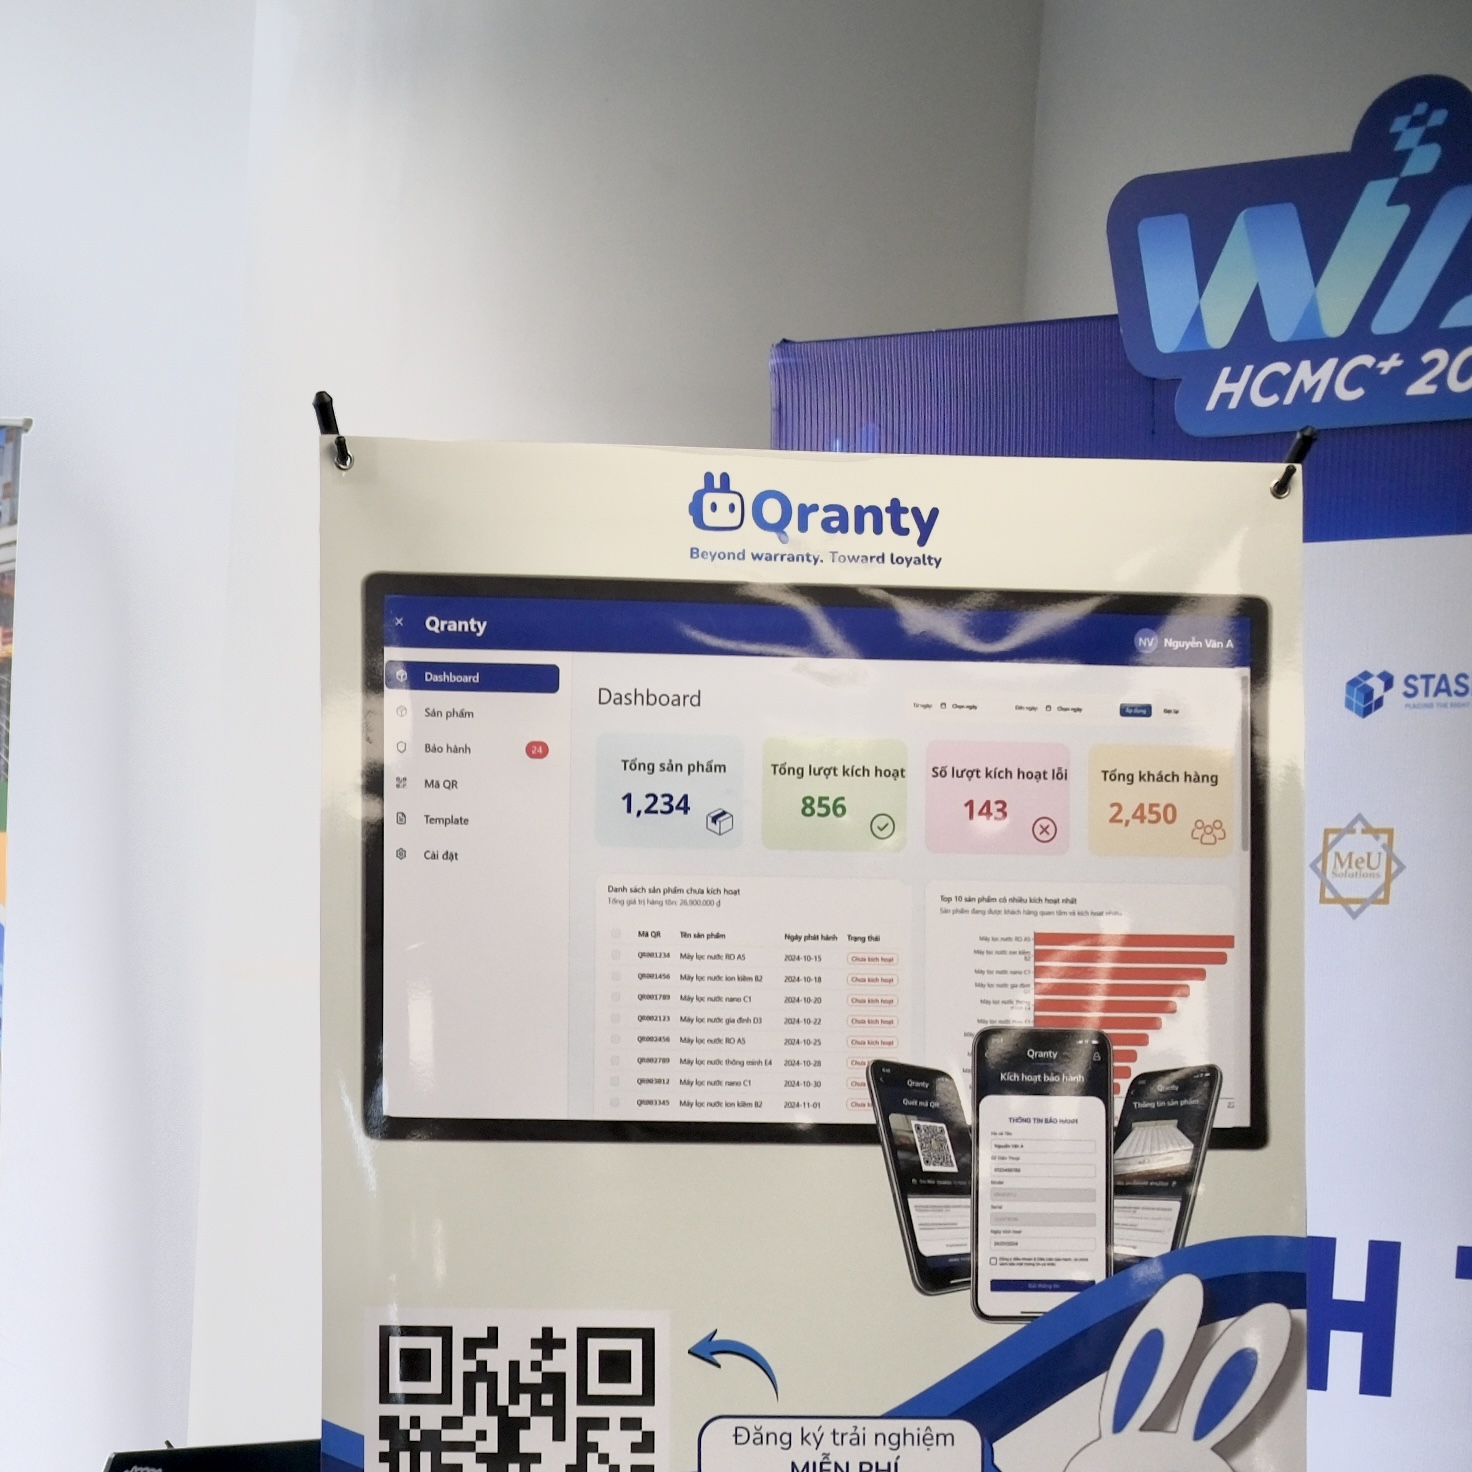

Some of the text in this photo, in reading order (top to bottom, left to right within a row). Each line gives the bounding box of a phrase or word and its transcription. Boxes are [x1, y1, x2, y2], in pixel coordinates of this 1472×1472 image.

[751, 488, 940, 547] Qranty
[689, 546, 942, 569] Beyond warranty. Toward loyalty
[425, 615, 487, 636] Qranty
[1139, 637, 1155, 647] NV
[1164, 636, 1233, 650] Nguyễn Văn A
[424, 671, 479, 683] Dashboard
[1402, 673, 1472, 699] STAS
[598, 687, 700, 707] Dashboard
[424, 707, 474, 720] Sản phẩm
[424, 743, 471, 754] Bảo hành
[531, 745, 542, 754] 24
[621, 757, 726, 776] Tổng sản phẩm
[770, 761, 905, 781] Tổng lượt kích hoạt
[931, 765, 1067, 783] Số lượt kích hoạt lỗi
[424, 778, 457, 790] Mã QR
[1101, 768, 1218, 786] Tổng khách hàng
[621, 792, 690, 818] 1,234
[800, 795, 846, 818] 856
[963, 799, 1007, 820] 143
[423, 814, 469, 827] Template
[1108, 802, 1177, 827] 2,450
[423, 849, 458, 862] Cài đặt
[1333, 851, 1382, 872] MeU
[1331, 869, 1381, 879] Solutions
[1027, 1048, 1058, 1059] Qranty
[1000, 1072, 1019, 1080] Kích
[1021, 1073, 1040, 1081] hoạt
[1043, 1073, 1060, 1082] bảo
[732, 1424, 955, 1455] Đăng ký trải nghiệm
